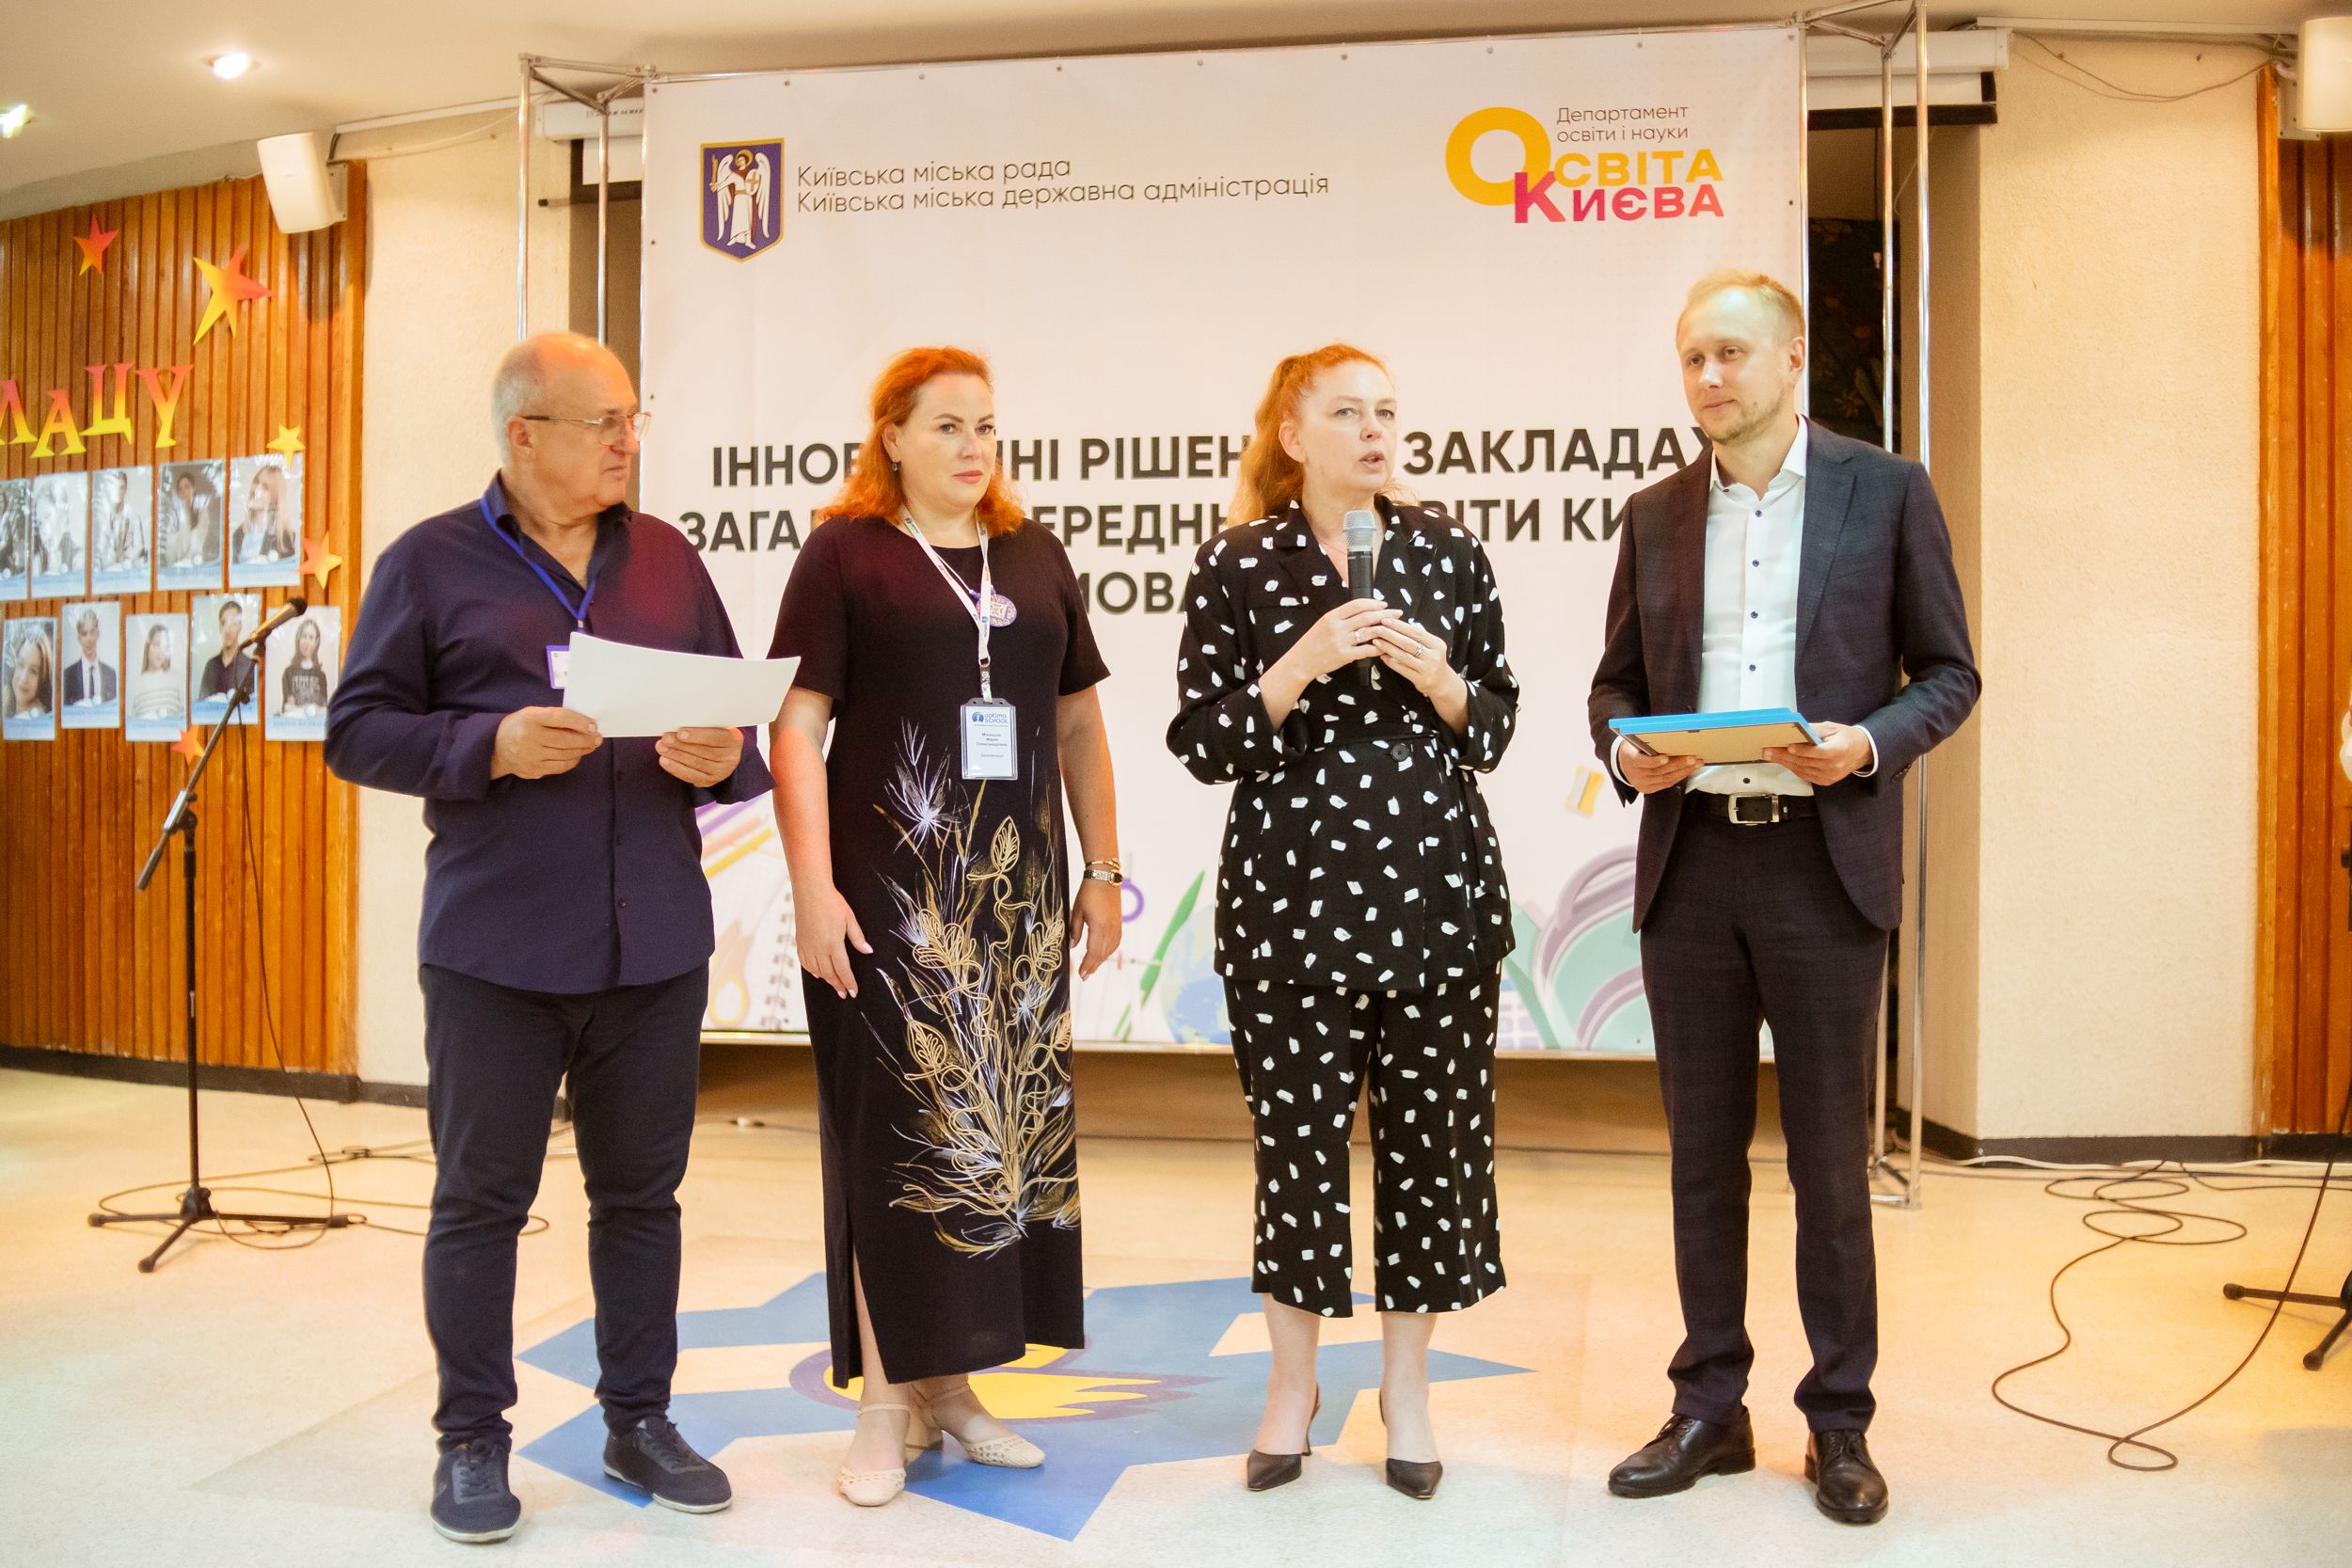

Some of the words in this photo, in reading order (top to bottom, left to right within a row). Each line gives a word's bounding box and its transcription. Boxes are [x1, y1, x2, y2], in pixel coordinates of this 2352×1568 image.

[1556, 106, 1689, 124] Департамент
[1556, 127, 1616, 142] освіти
[1621, 126, 1627, 140] і
[1631, 126, 1689, 144] науки
[797, 166, 905, 187] Київська
[913, 161, 994, 182] міська
[1003, 160, 1071, 184] рада
[1445, 106, 1724, 206] ОСВІТА
[797, 190, 905, 213] Київська
[913, 187, 994, 209] міська
[1002, 182, 1135, 210] державна
[1143, 173, 1328, 203] адміністрація
[1514, 171, 1724, 223] КИЄВА
[1080, 436, 1250, 480] РІШЕН
